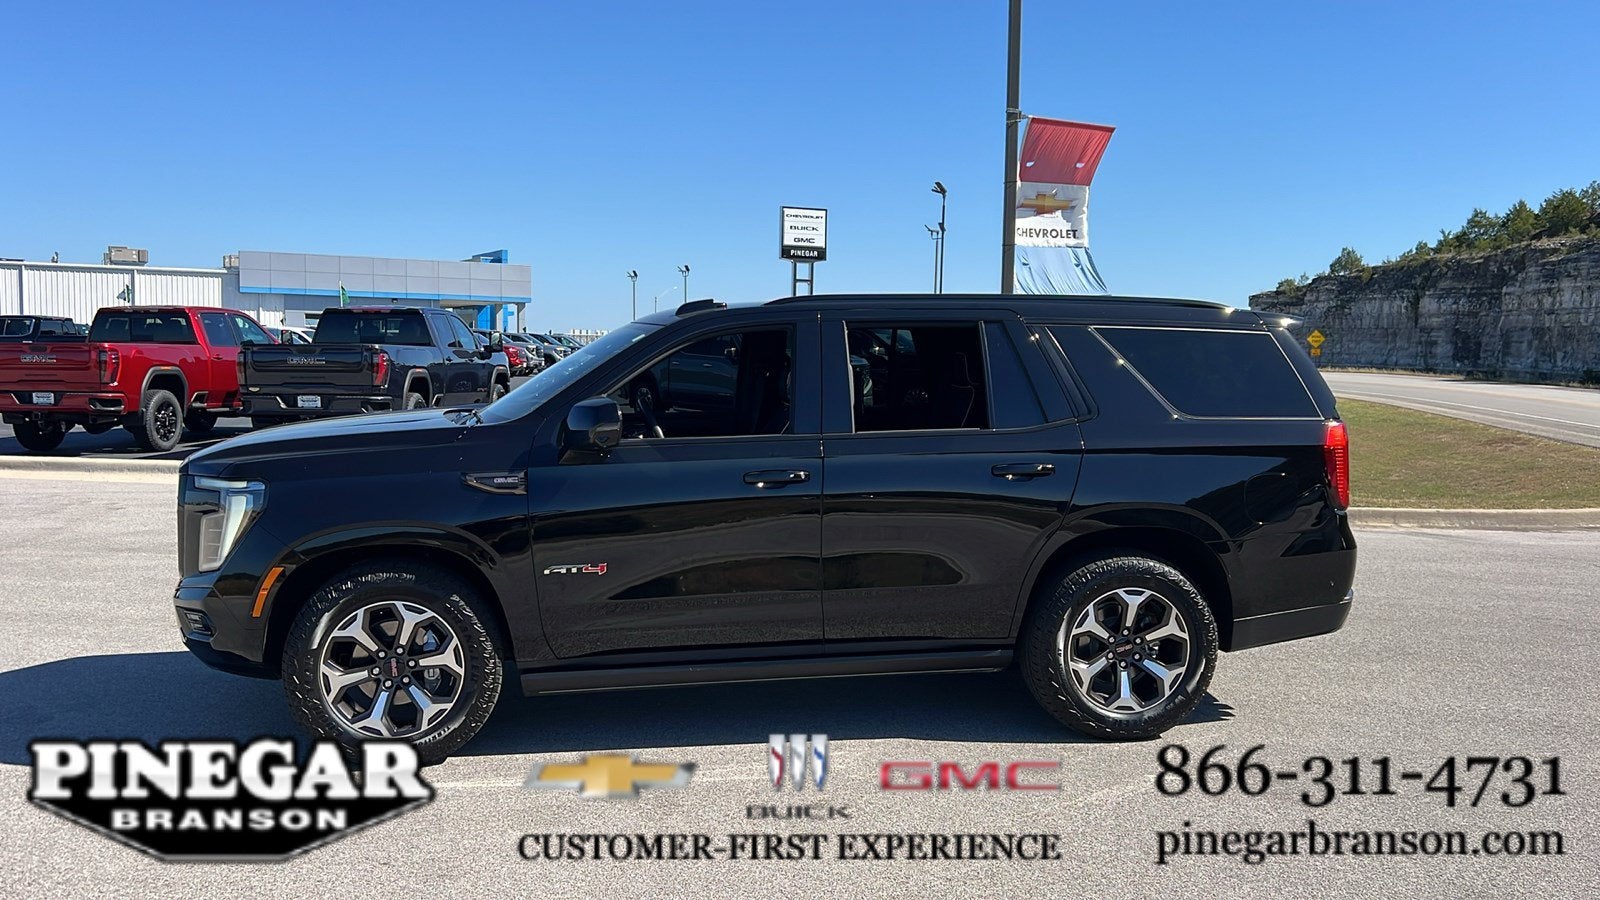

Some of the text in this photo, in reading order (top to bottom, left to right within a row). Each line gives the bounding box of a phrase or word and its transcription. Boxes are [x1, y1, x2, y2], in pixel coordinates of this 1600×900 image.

[1016, 227, 1078, 239] CHEVROLET
[790, 249, 818, 257] PINEGAR
[20, 354, 57, 363] GMC
[286, 356, 326, 365] GMC
[493, 476, 519, 484] GMC
[543, 563, 608, 575] AT4
